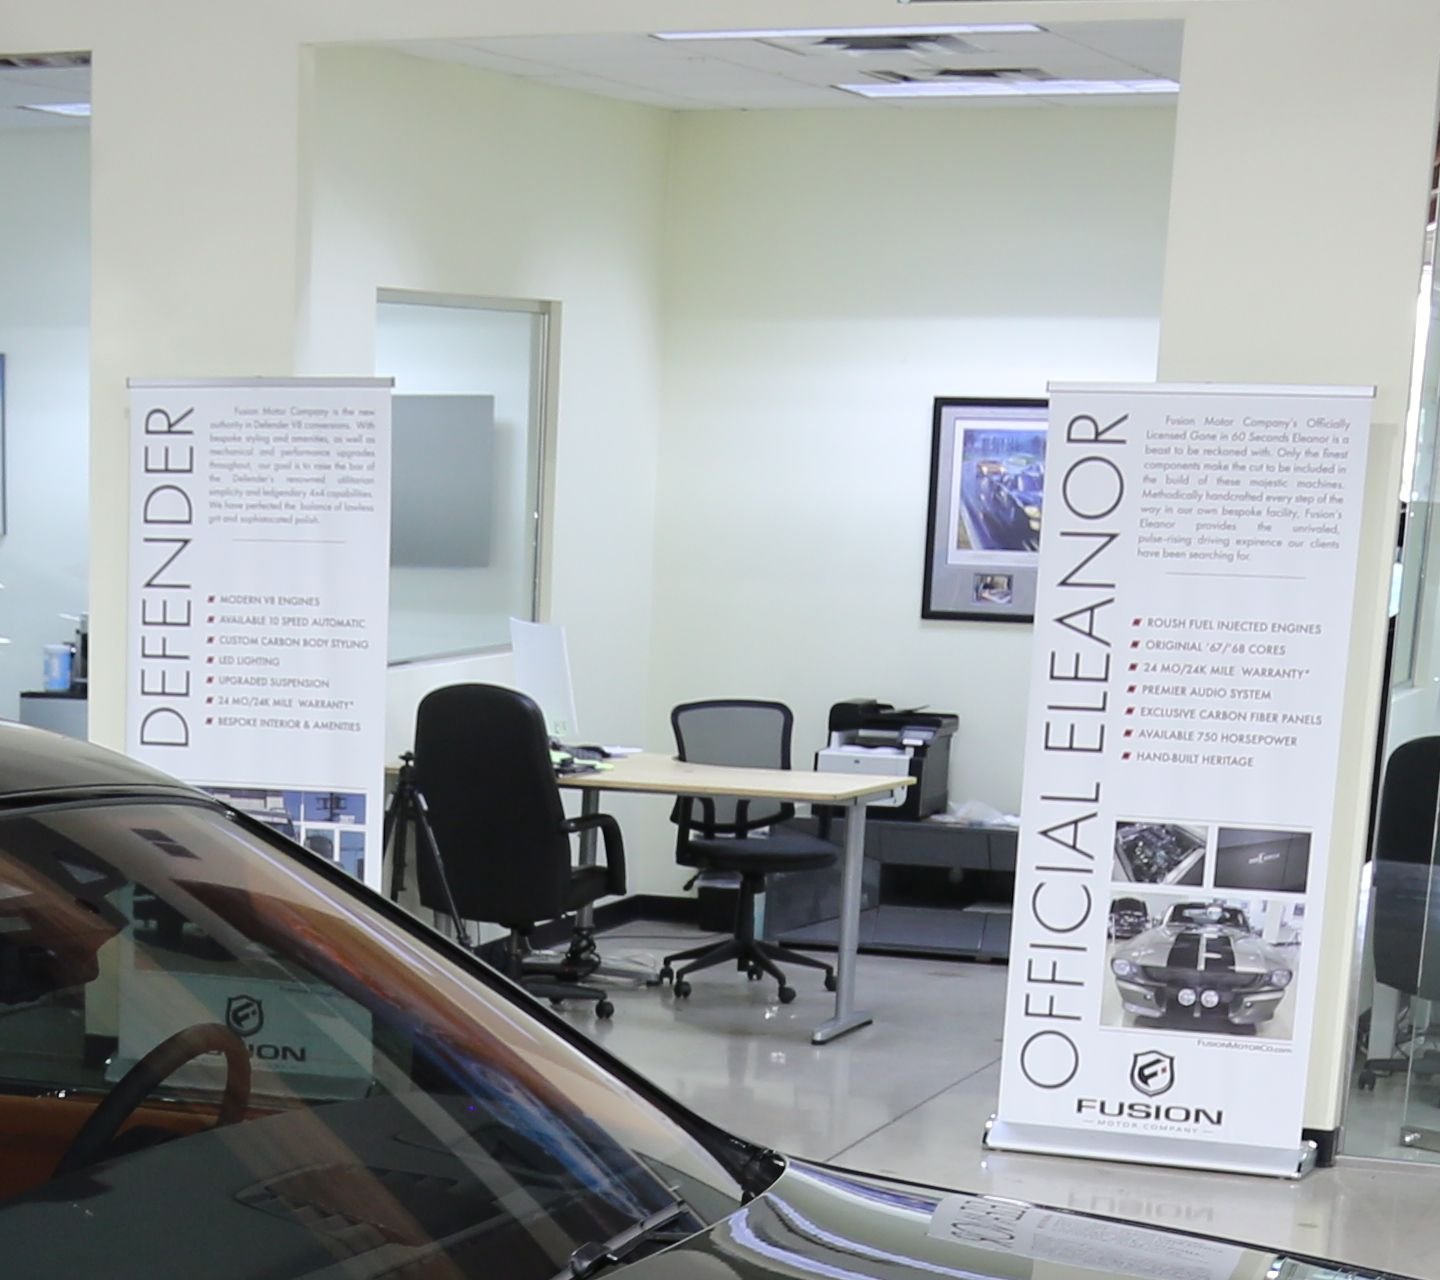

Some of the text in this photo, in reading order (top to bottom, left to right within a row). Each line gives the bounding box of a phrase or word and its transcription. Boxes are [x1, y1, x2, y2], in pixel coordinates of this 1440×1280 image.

[140, 406, 195, 747] DEFENDER
[220, 595, 320, 607] MODERN V8 ENGINES
[220, 616, 364, 629] AVAILABLE 10 SPEED AUTOMATIC
[1148, 618, 1321, 635] ROUSH FUEL INJECTED ENGINES
[219, 636, 368, 650] CUSTOM CARBON BODY STYLING
[1146, 640, 1201, 653] ORIGINIAL
[1249, 644, 1285, 656] CORES
[219, 656, 280, 667] LED LIGHTING
[1144, 663, 1157, 674] 24
[1161, 663, 1206, 676] MO/24K
[1210, 665, 1234, 677] MILE
[219, 676, 329, 689] UPGRADED SUSPENSION
[1143, 685, 1271, 700] PREMIER AUDIO SYSTEM
[219, 696, 229, 706] 24
[232, 696, 269, 708] MO/24K
[273, 698, 292, 708] MILE
[1141, 707, 1321, 726] EXCLUSIVE CARBON FIBER PANELS
[218, 717, 360, 732] BESPOKE INTERIOR & AMENITIES
[1139, 729, 1296, 747] AVAILABLE 750 HORSEPOWER
[1020, 413, 1129, 1090] OFFICIAL ELEANOR
[1137, 752, 1252, 768] HAND-BUILT HERITAGE
[1076, 1098, 1223, 1126] FUSION
[1097, 1119, 1199, 1134] MOTOR COMPANY
